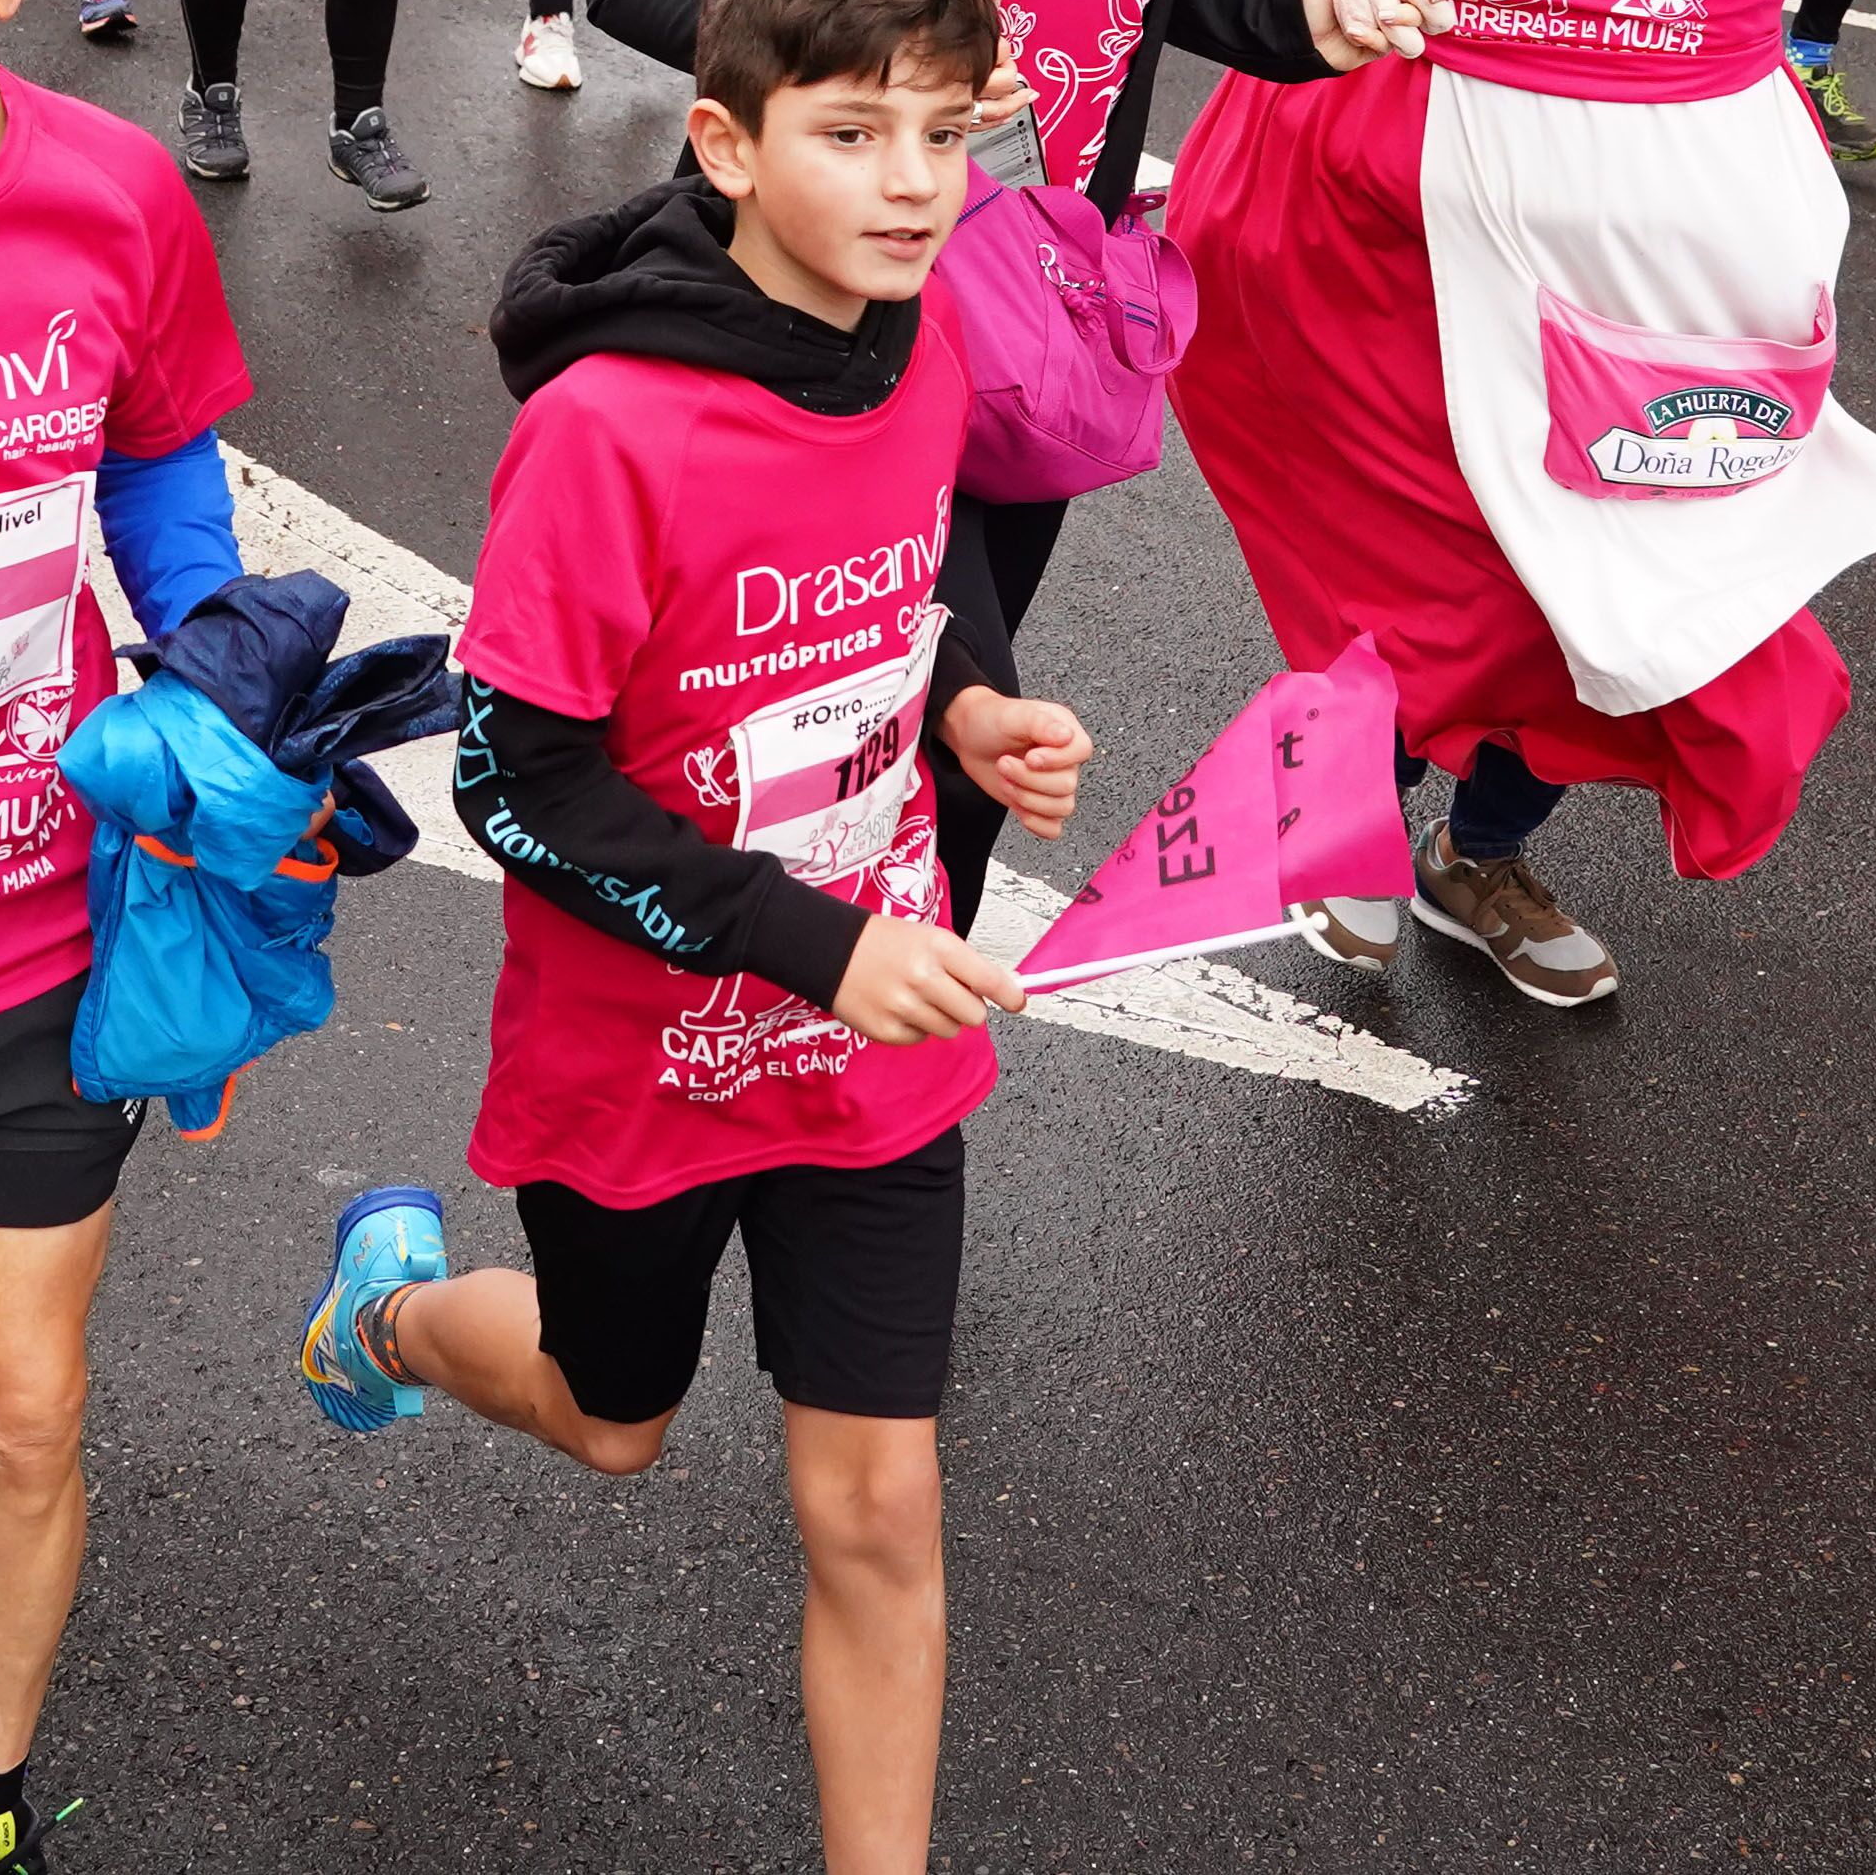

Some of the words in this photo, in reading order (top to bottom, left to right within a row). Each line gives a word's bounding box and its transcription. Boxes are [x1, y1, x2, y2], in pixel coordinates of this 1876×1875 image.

[1549, 19, 1577, 38] DE
[1581, 20, 1597, 39] LA
[1603, 16, 1704, 55] MUJER
[1649, 405, 1674, 426] LA
[1677, 392, 1751, 415] HUERTA
[1754, 402, 1783, 426] DE
[3, 444, 28, 461] hair
[36, 438, 76, 455] beauty
[1613, 438, 1693, 475] Doña
[3, 855, 56, 894] MAMA
[767, 1061, 793, 1077] EL
